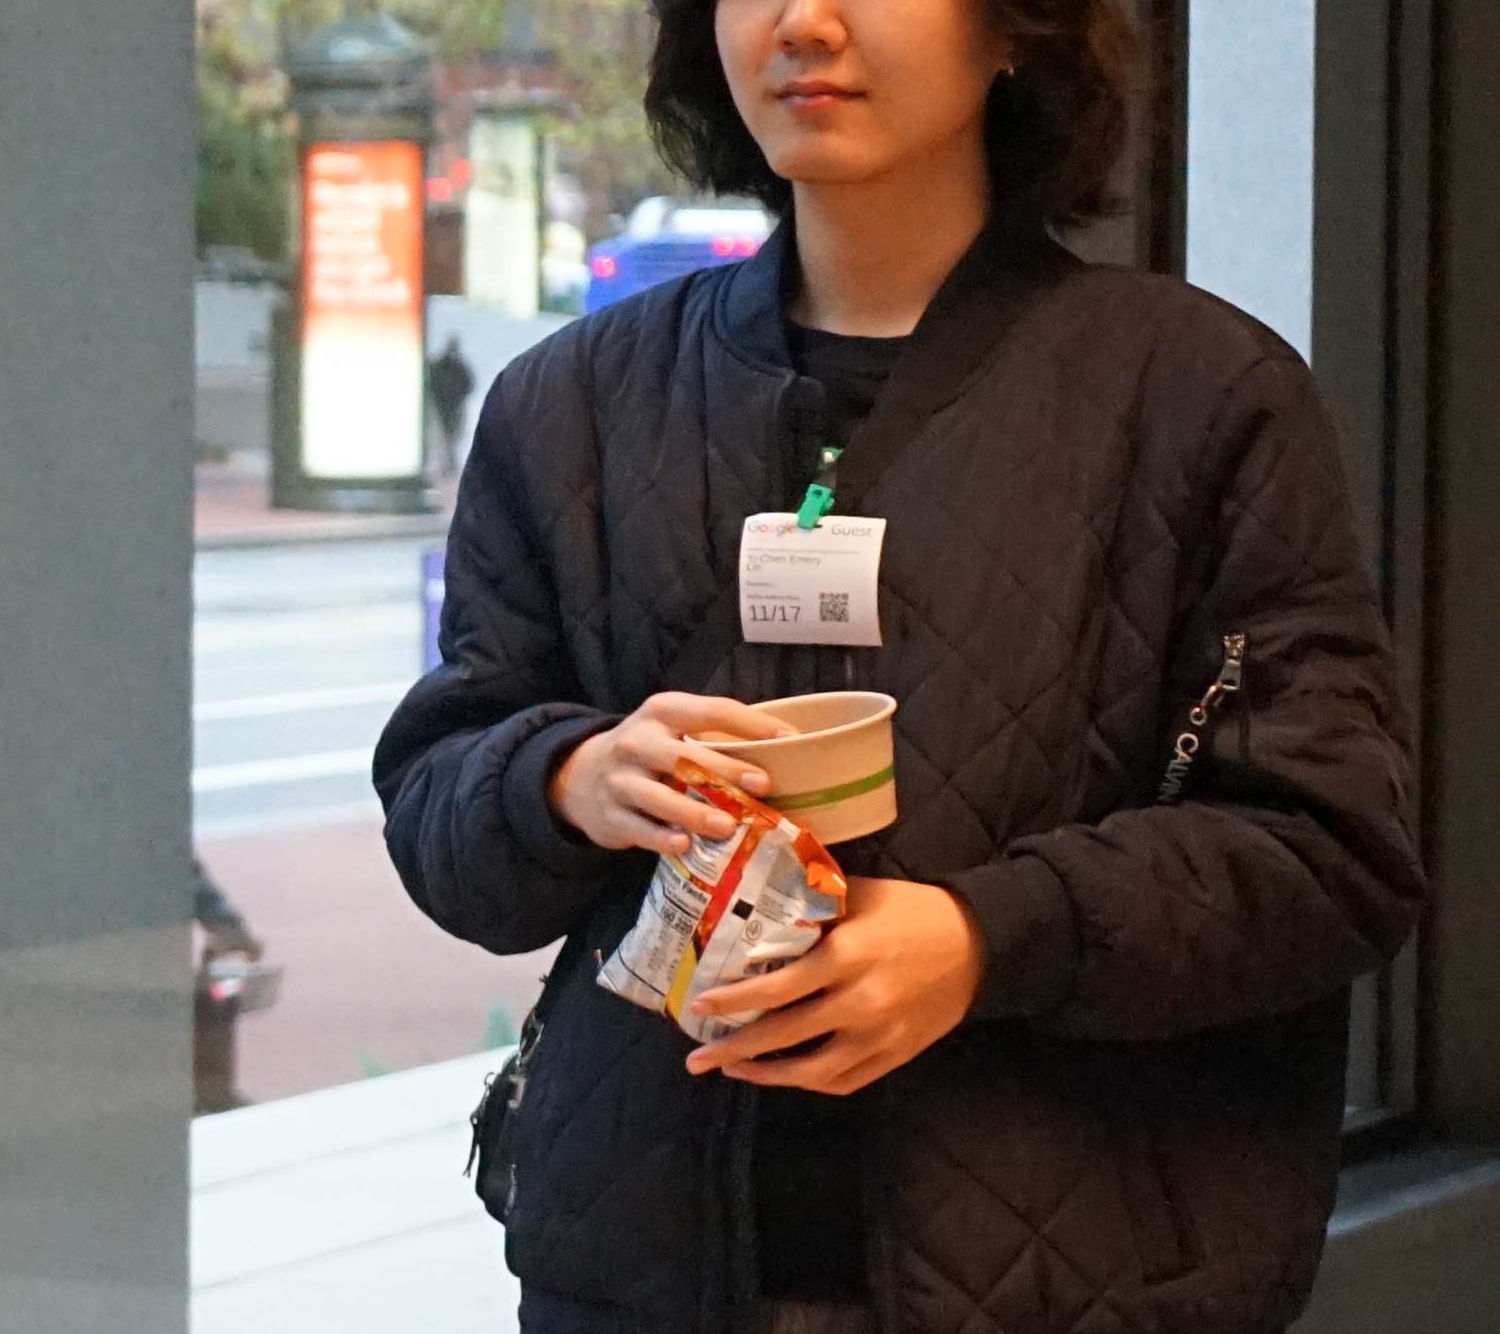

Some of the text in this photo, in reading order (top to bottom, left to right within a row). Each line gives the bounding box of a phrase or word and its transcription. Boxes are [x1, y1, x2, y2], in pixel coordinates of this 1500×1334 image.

[748, 520, 873, 537] Google Guest
[749, 604, 801, 622] 11/17
